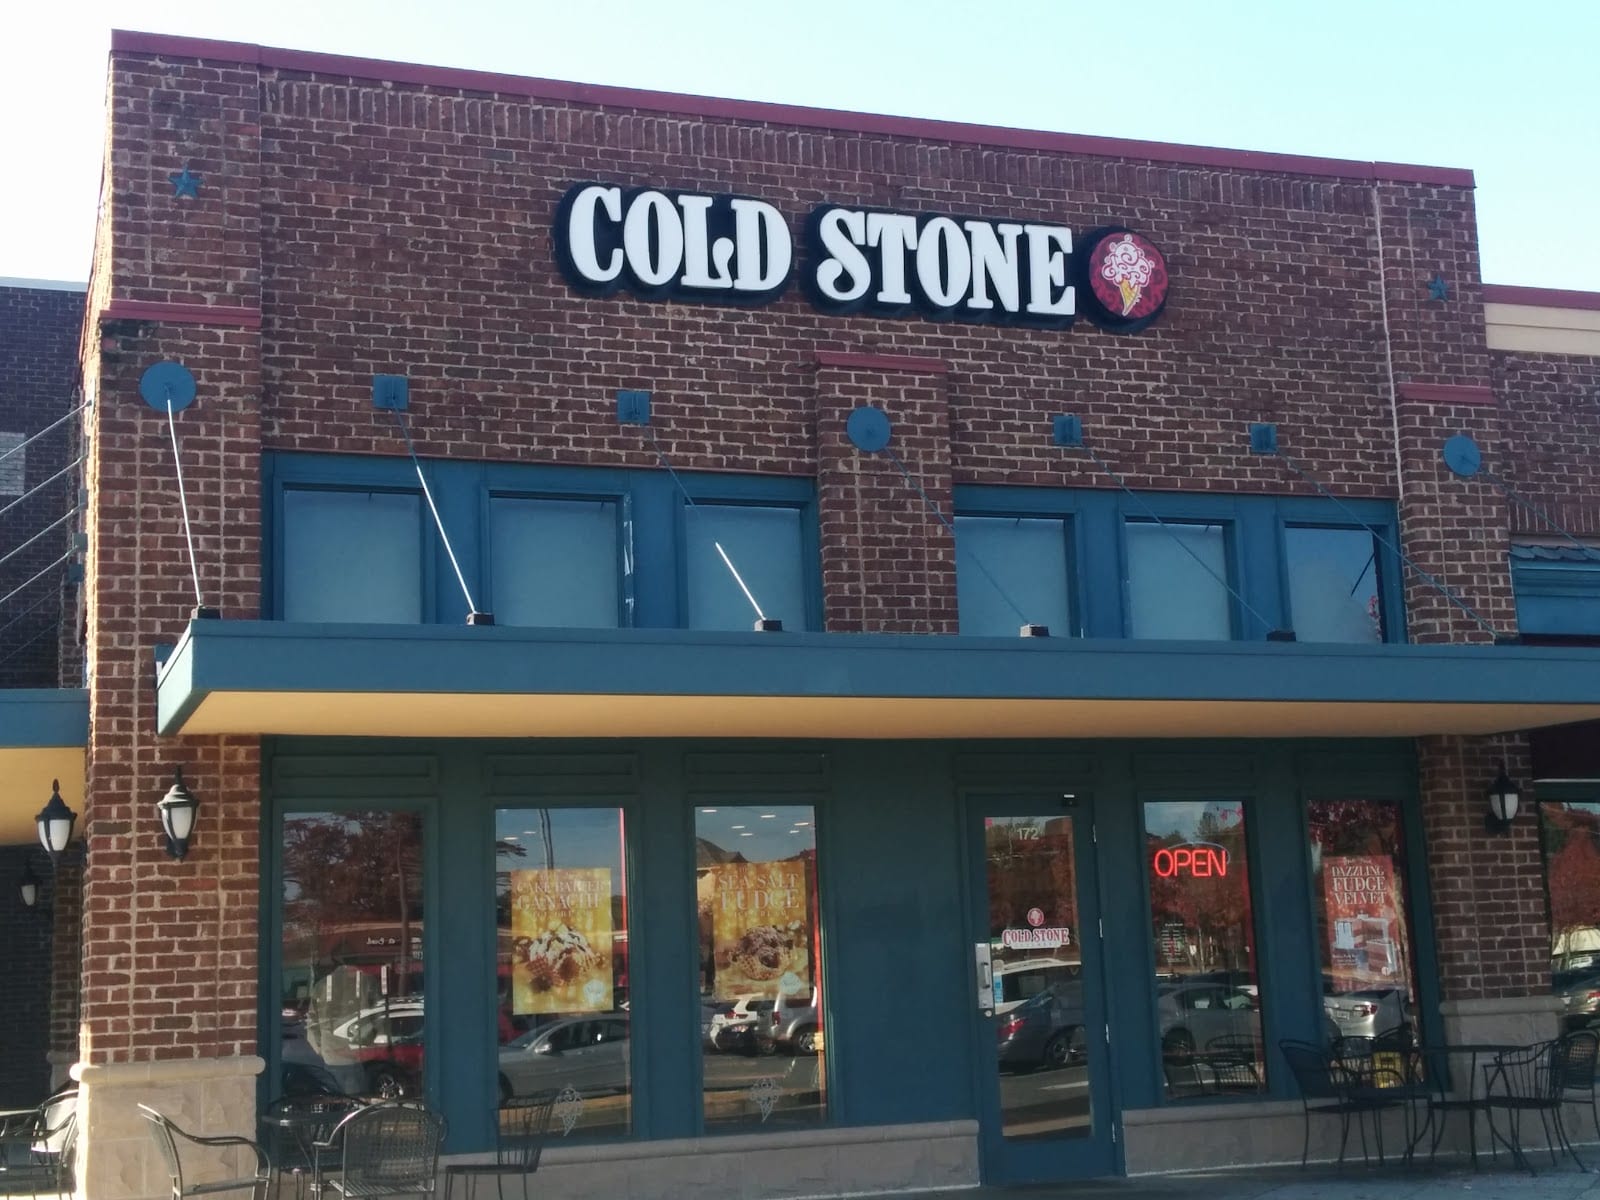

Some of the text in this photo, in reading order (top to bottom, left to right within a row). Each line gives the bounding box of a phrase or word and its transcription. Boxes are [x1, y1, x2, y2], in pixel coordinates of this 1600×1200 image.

[569, 186, 1076, 315] COLD STONE
[1017, 827, 1040, 840] 172
[1154, 849, 1226, 877] OPEN
[1332, 865, 1385, 877] DAZZLING
[719, 872, 801, 890] SEA SALT
[1333, 876, 1387, 892] FUDGE
[721, 888, 800, 912] FUDGE
[1334, 891, 1387, 905] VELVET
[1003, 930, 1031, 945] COLD
[1034, 929, 1069, 944] STONE
